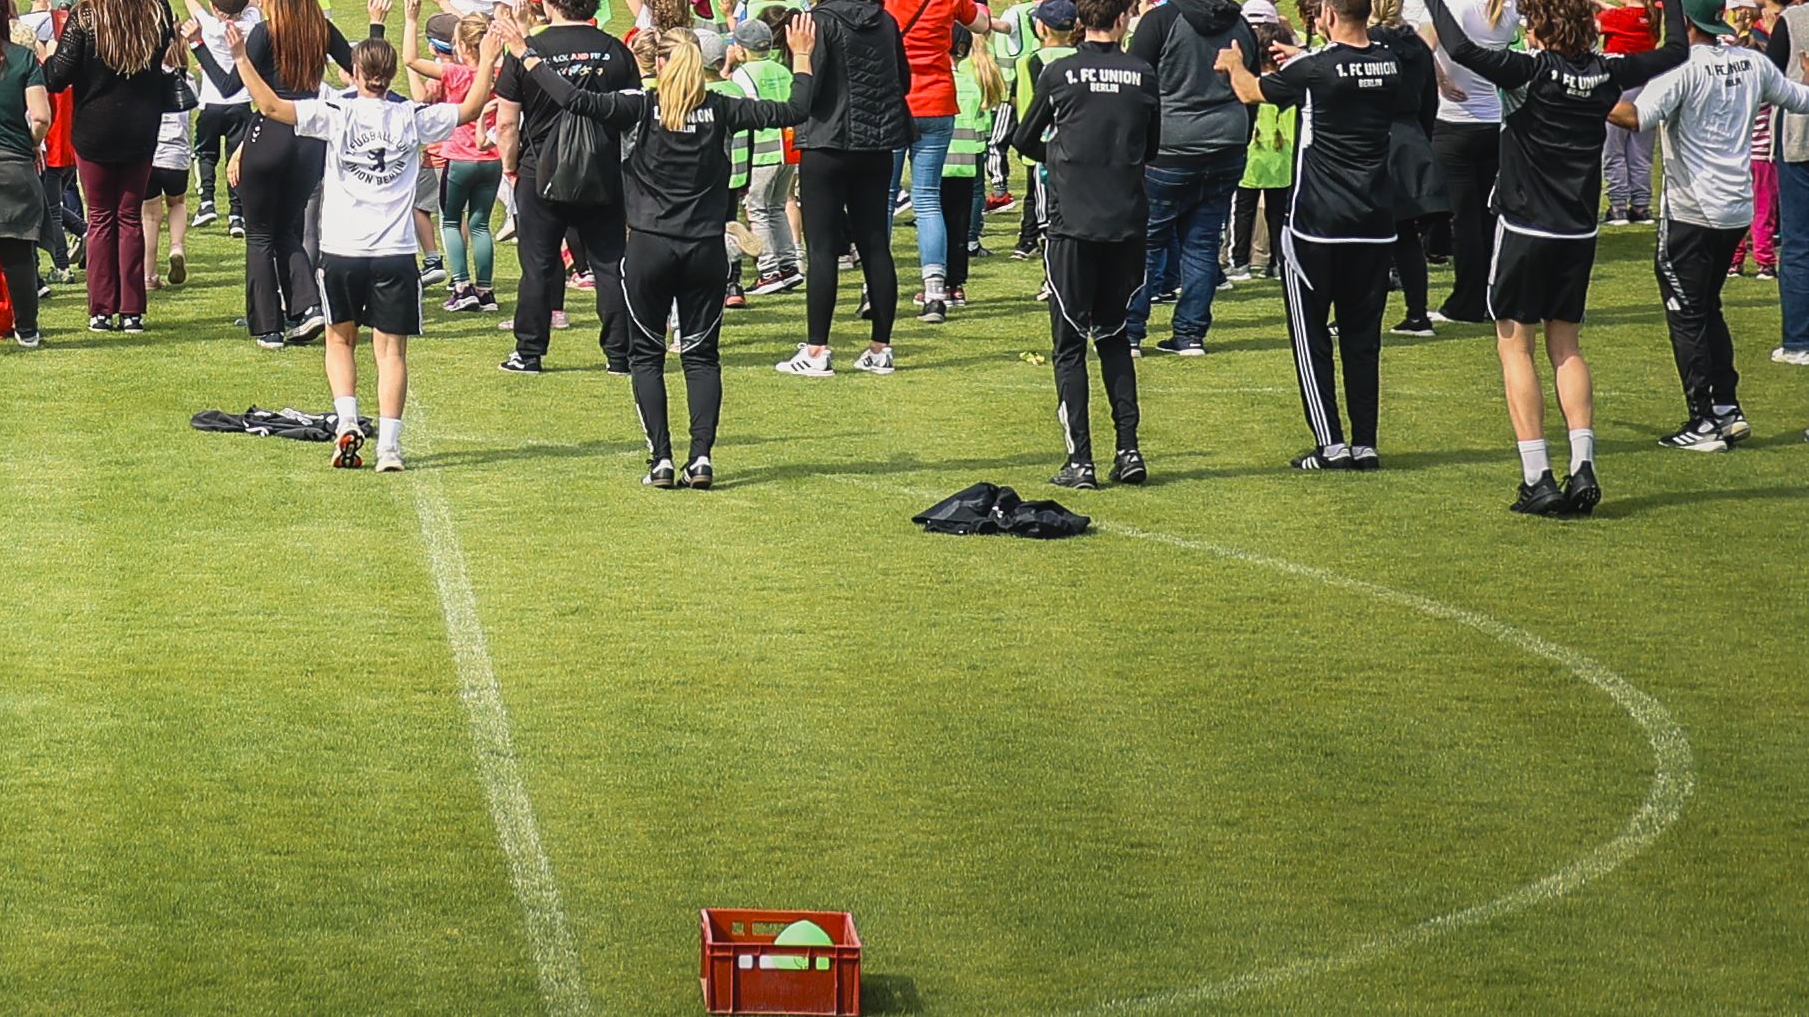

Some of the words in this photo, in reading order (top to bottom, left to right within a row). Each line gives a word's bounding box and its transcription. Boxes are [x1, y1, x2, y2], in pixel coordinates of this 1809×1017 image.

[570, 52, 590, 61] AND
[1065, 69, 1078, 85] 1.
[1080, 68, 1097, 83] FC
[1099, 69, 1142, 86] UNION
[1336, 64, 1348, 77] 1.
[1349, 63, 1363, 77] FC
[1363, 61, 1398, 77] UNION
[1089, 82, 1120, 94] BERLIN
[1357, 78, 1383, 88] BERLIN
[1562, 73, 1578, 86] FC
[1578, 72, 1611, 91] UNION
[376, 160, 406, 186] BERLIN
